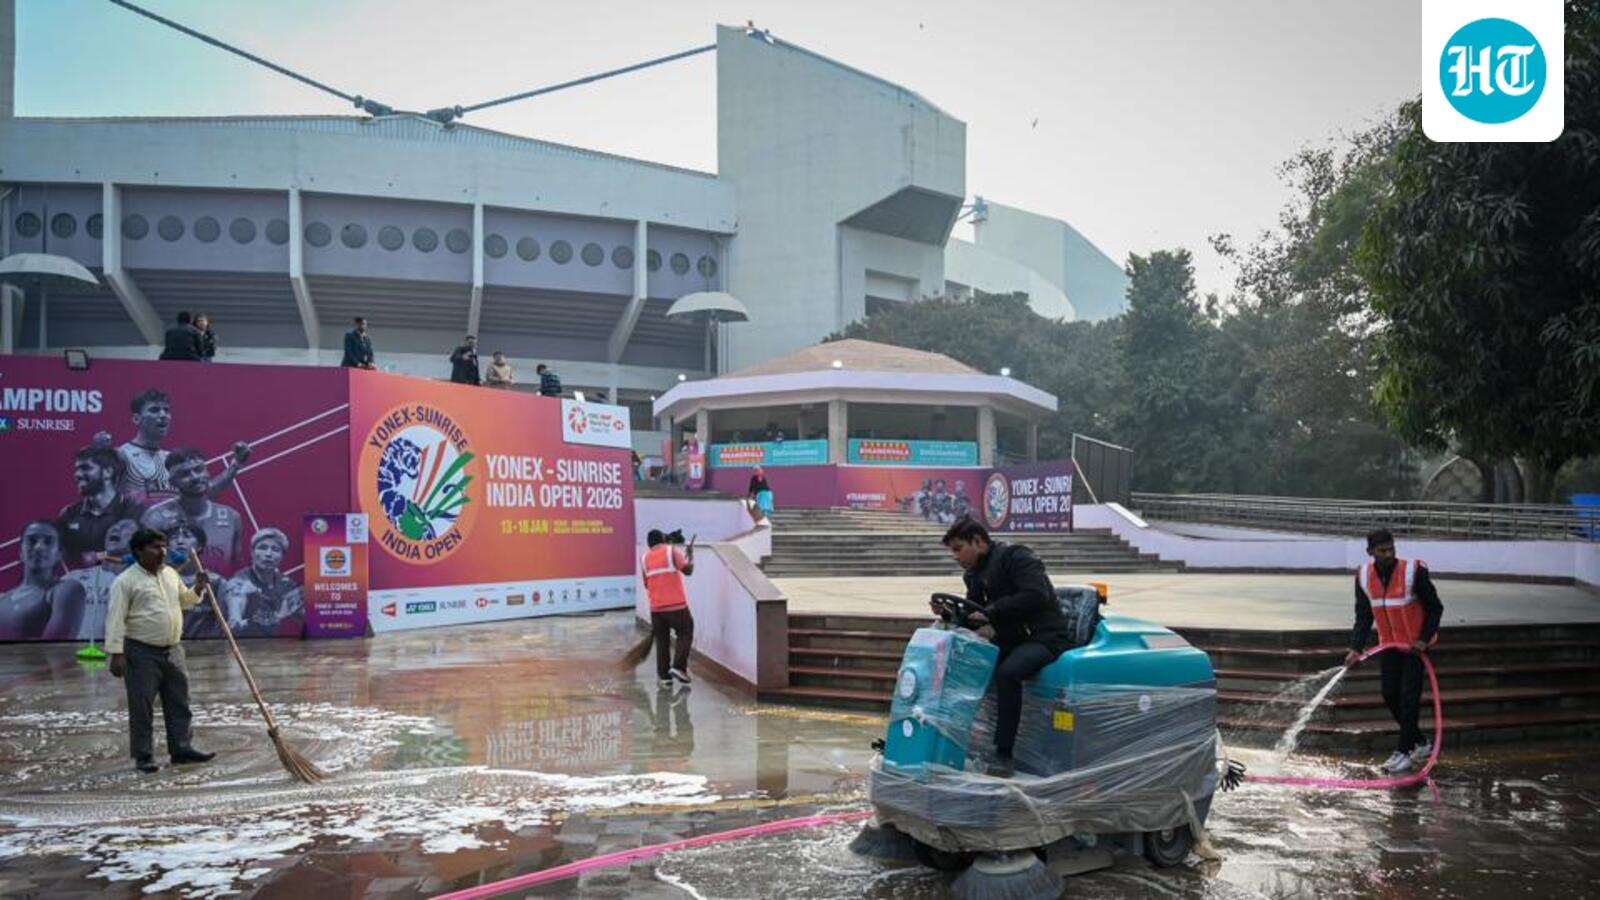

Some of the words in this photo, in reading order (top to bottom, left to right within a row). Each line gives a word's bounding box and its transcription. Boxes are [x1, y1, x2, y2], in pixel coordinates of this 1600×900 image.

[0, 388, 102, 413] MPIONS
[17, 418, 75, 431] SUNRISE
[369, 405, 468, 453] YONEX-SUNRISE
[485, 454, 543, 480] YONEX
[556, 459, 621, 484] SUNRISE
[486, 482, 535, 508] INDIA
[540, 484, 582, 508] OPEN
[586, 486, 622, 510] 2026
[1011, 478, 1039, 496] YONEX
[1010, 497, 1033, 514] INDIA
[1034, 496, 1058, 513] OPEN
[381, 528, 421, 561] INDIA
[425, 527, 463, 560] OPEN
